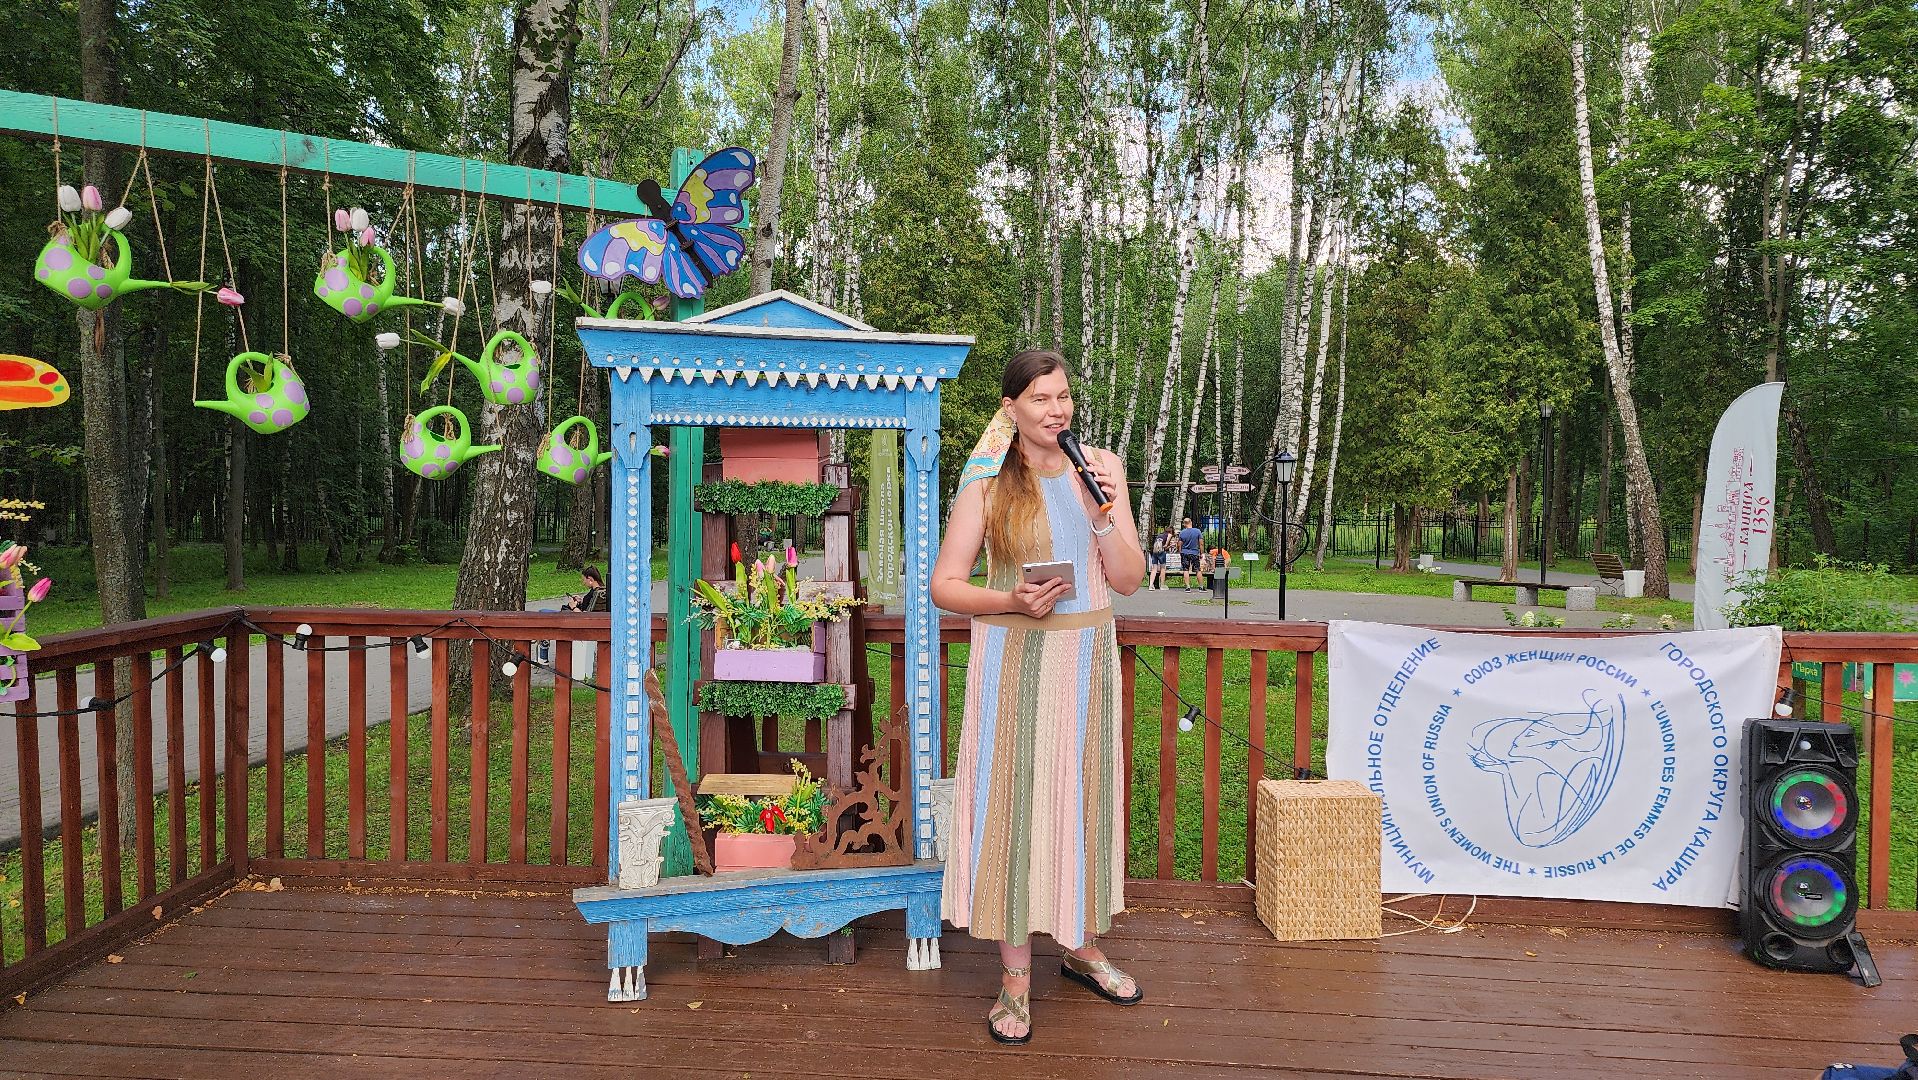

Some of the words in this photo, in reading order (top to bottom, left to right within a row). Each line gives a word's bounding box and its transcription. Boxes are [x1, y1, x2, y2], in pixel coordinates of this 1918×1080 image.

[1739, 482, 1754, 547] КАШИРА
[1752, 496, 1770, 535] 1356
[1374, 637, 1441, 727] ОТДЕЛЕНИЕ
[1463, 656, 1502, 684] СОЮЗ
[1505, 650, 1575, 665] ЖЕНЩИН
[1576, 654, 1638, 688] РОССИИ
[1660, 642, 1727, 748] ГОРОДСКОГО
[1424, 704, 1452, 750] RUSSIA
[1650, 700, 1676, 753] L'UNION
[1422, 753, 1435, 771] OF
[1661, 756, 1675, 782] DES
[1367, 731, 1435, 884] МУНИЦИЛЬНОЕ
[1423, 775, 1446, 817] UNION
[1702, 754, 1728, 821] ОКРУГА
[1633, 786, 1671, 840] FEMMES
[1440, 818, 1492, 864] WOMEN'S
[1597, 850, 1616, 865] LA
[1615, 838, 1636, 856] DE
[1652, 826, 1712, 892] КАШИРА
[1492, 856, 1521, 875] THE
[1544, 858, 1596, 878] RUSSIE
